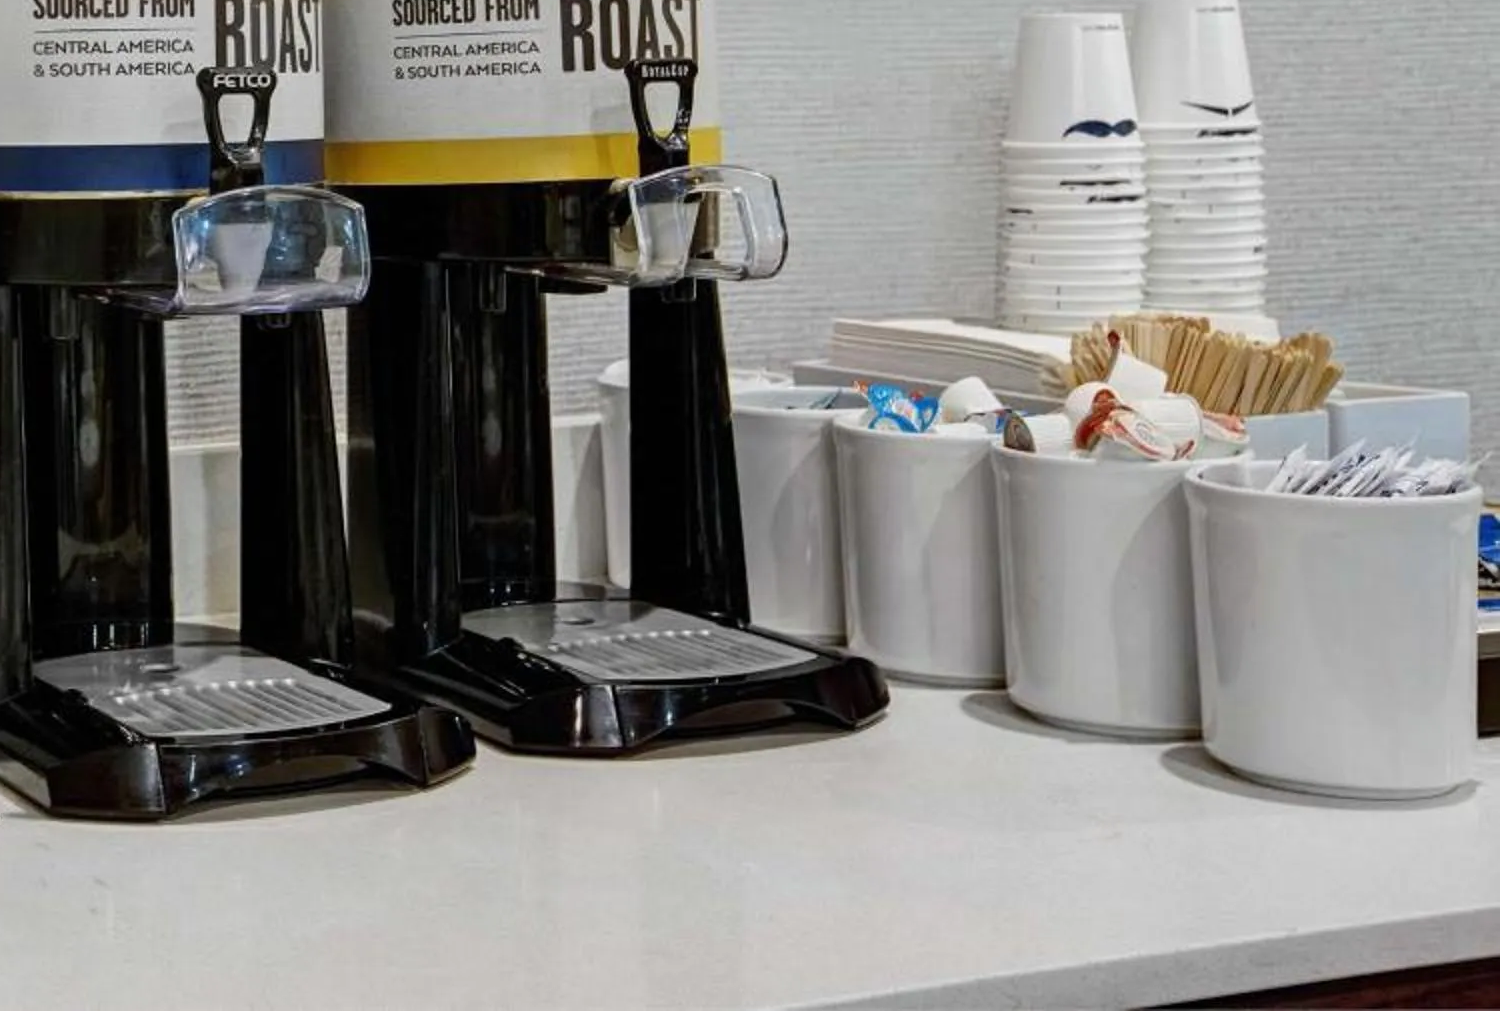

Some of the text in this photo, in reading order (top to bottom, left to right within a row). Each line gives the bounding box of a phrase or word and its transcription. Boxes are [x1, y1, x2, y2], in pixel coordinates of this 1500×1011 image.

[33, 39, 193, 55] CENTRAL AMERICA
[394, 41, 539, 59] CENTRAL AMERICA
[33, 61, 195, 77] & SOUTH AMERICA
[395, 62, 541, 79] & SOUTH AMERICA
[213, 74, 271, 88] FETCO
